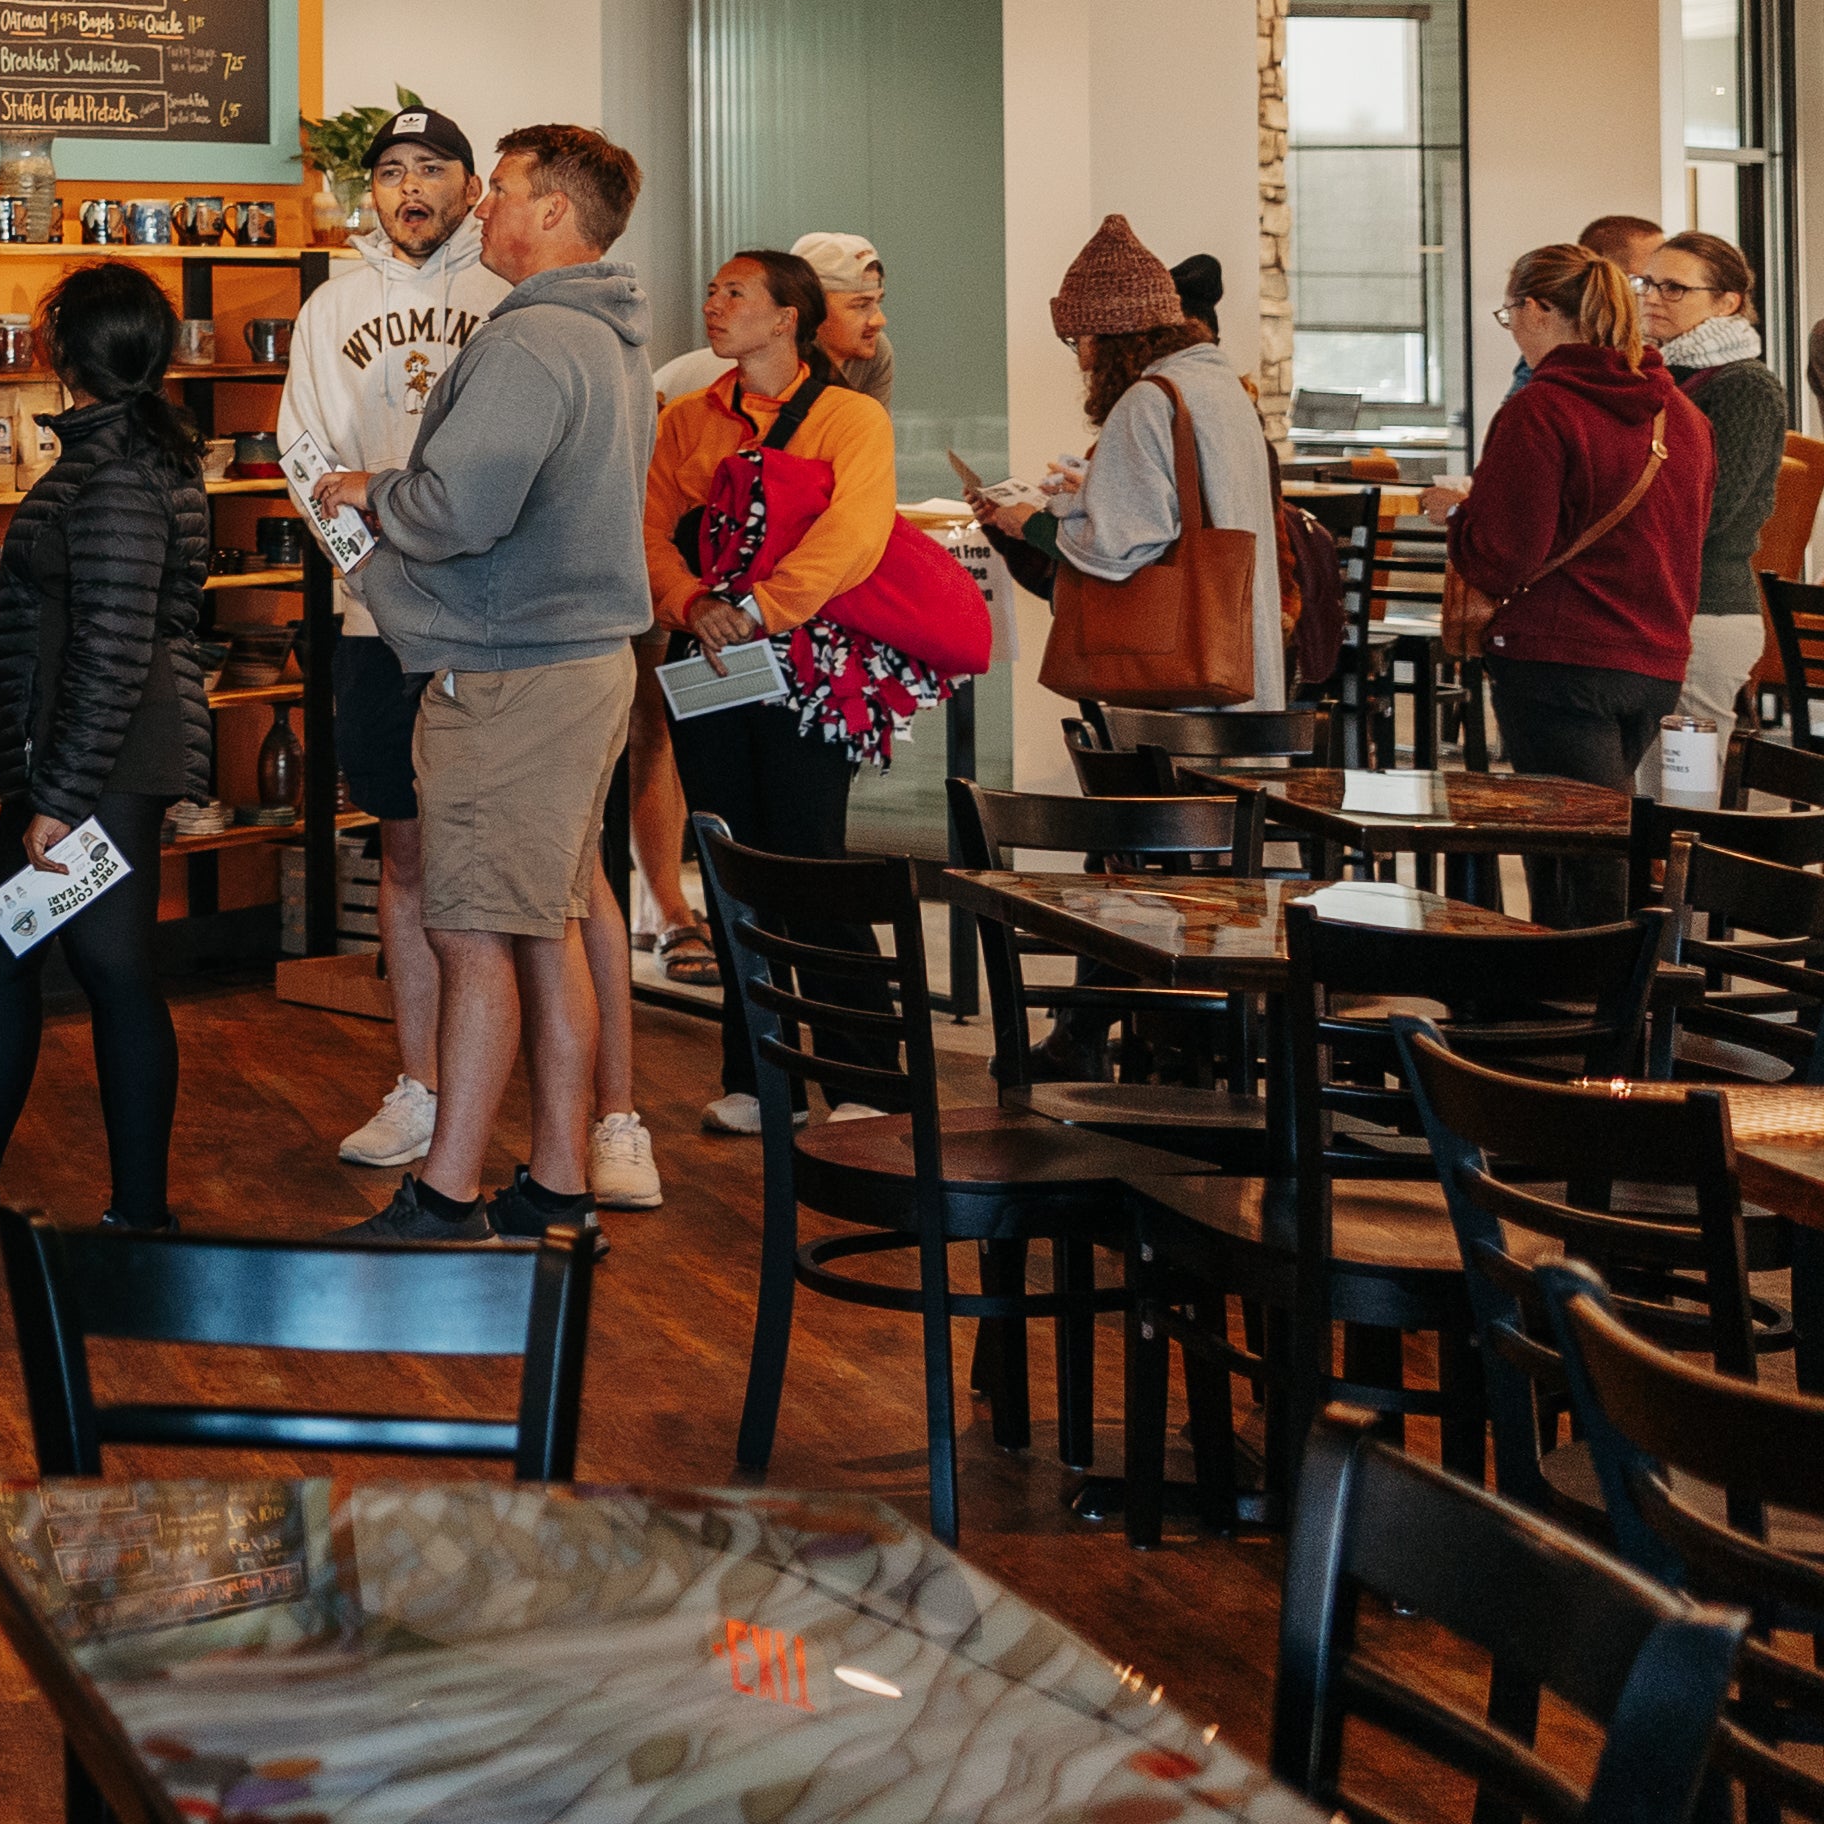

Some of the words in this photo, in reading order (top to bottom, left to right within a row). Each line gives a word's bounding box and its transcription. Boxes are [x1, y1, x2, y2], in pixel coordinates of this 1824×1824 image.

[342, 307, 490, 371] WYOMIN
[963, 544, 991, 559] Free
[94, 860, 119, 889] FREE
[49, 886, 94, 918] COFFEE
